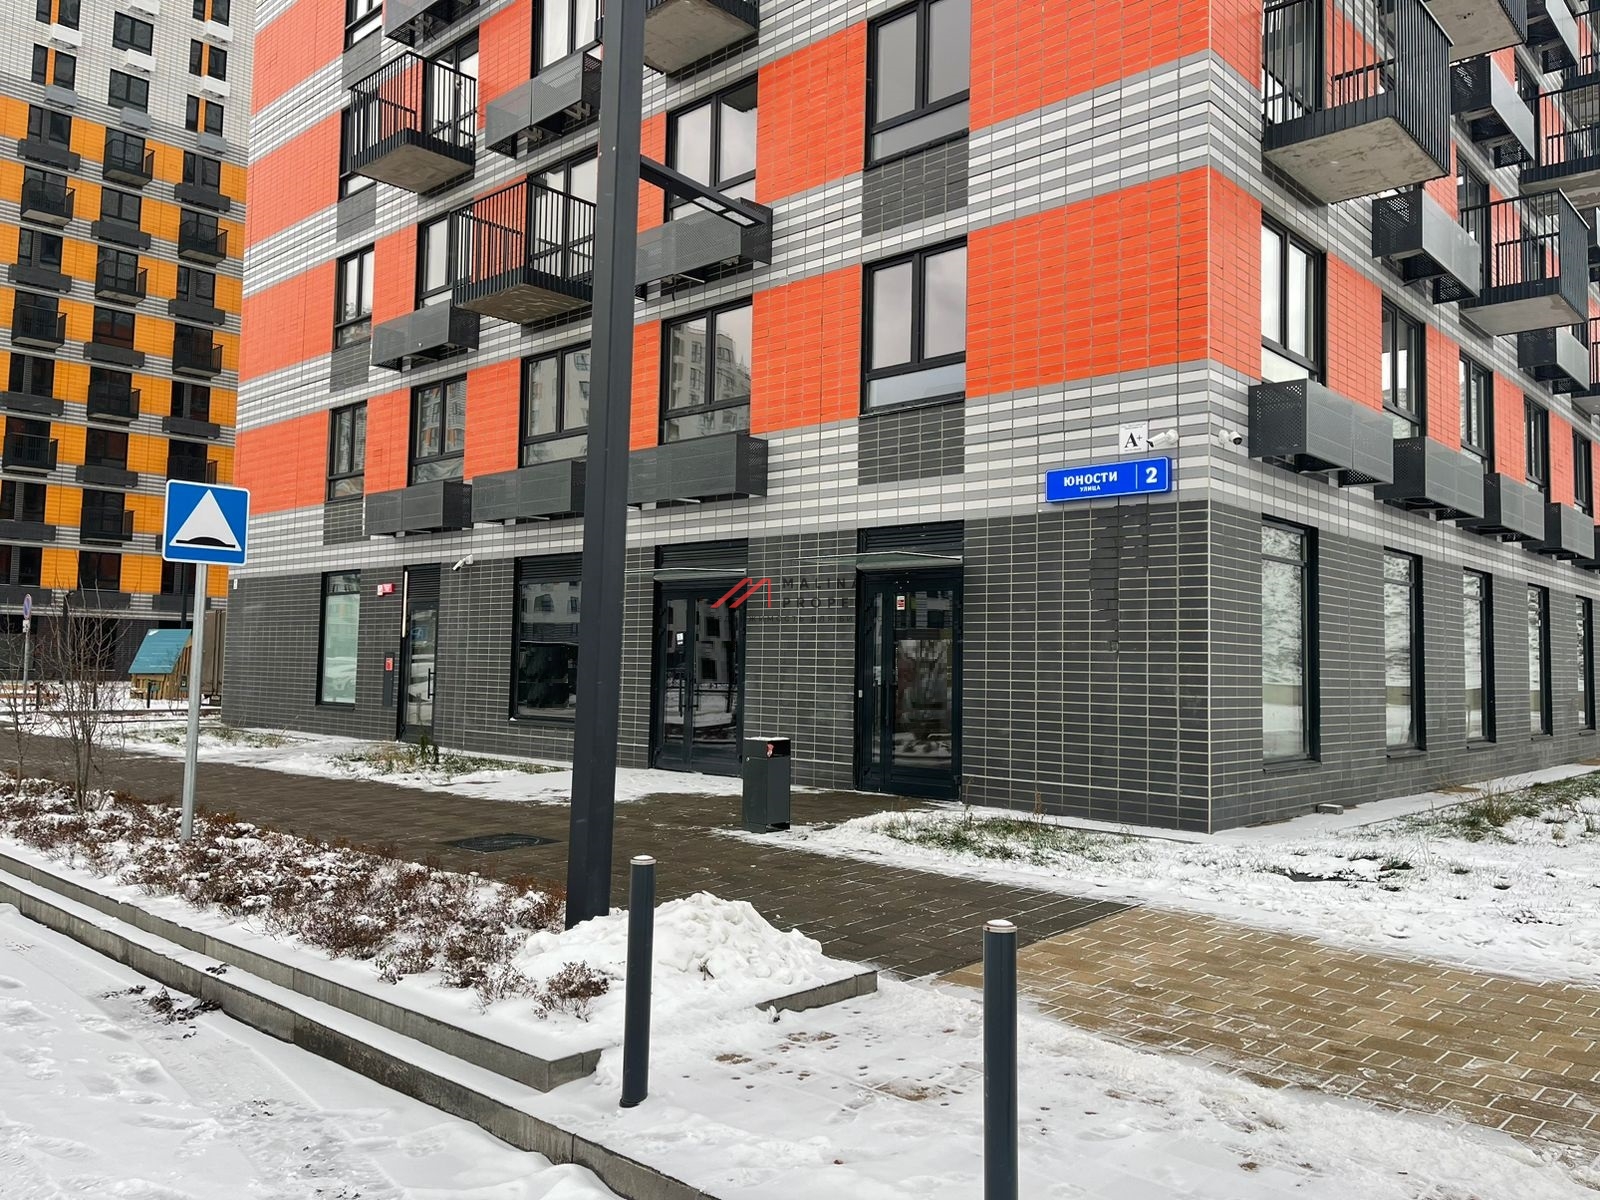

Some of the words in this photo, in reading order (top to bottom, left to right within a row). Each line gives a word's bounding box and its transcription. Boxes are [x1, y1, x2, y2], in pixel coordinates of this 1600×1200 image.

[1063, 470, 1118, 487] ЮНОСТИ
[1145, 467, 1158, 484] 2
[1079, 485, 1101, 493] УЛИЦА
